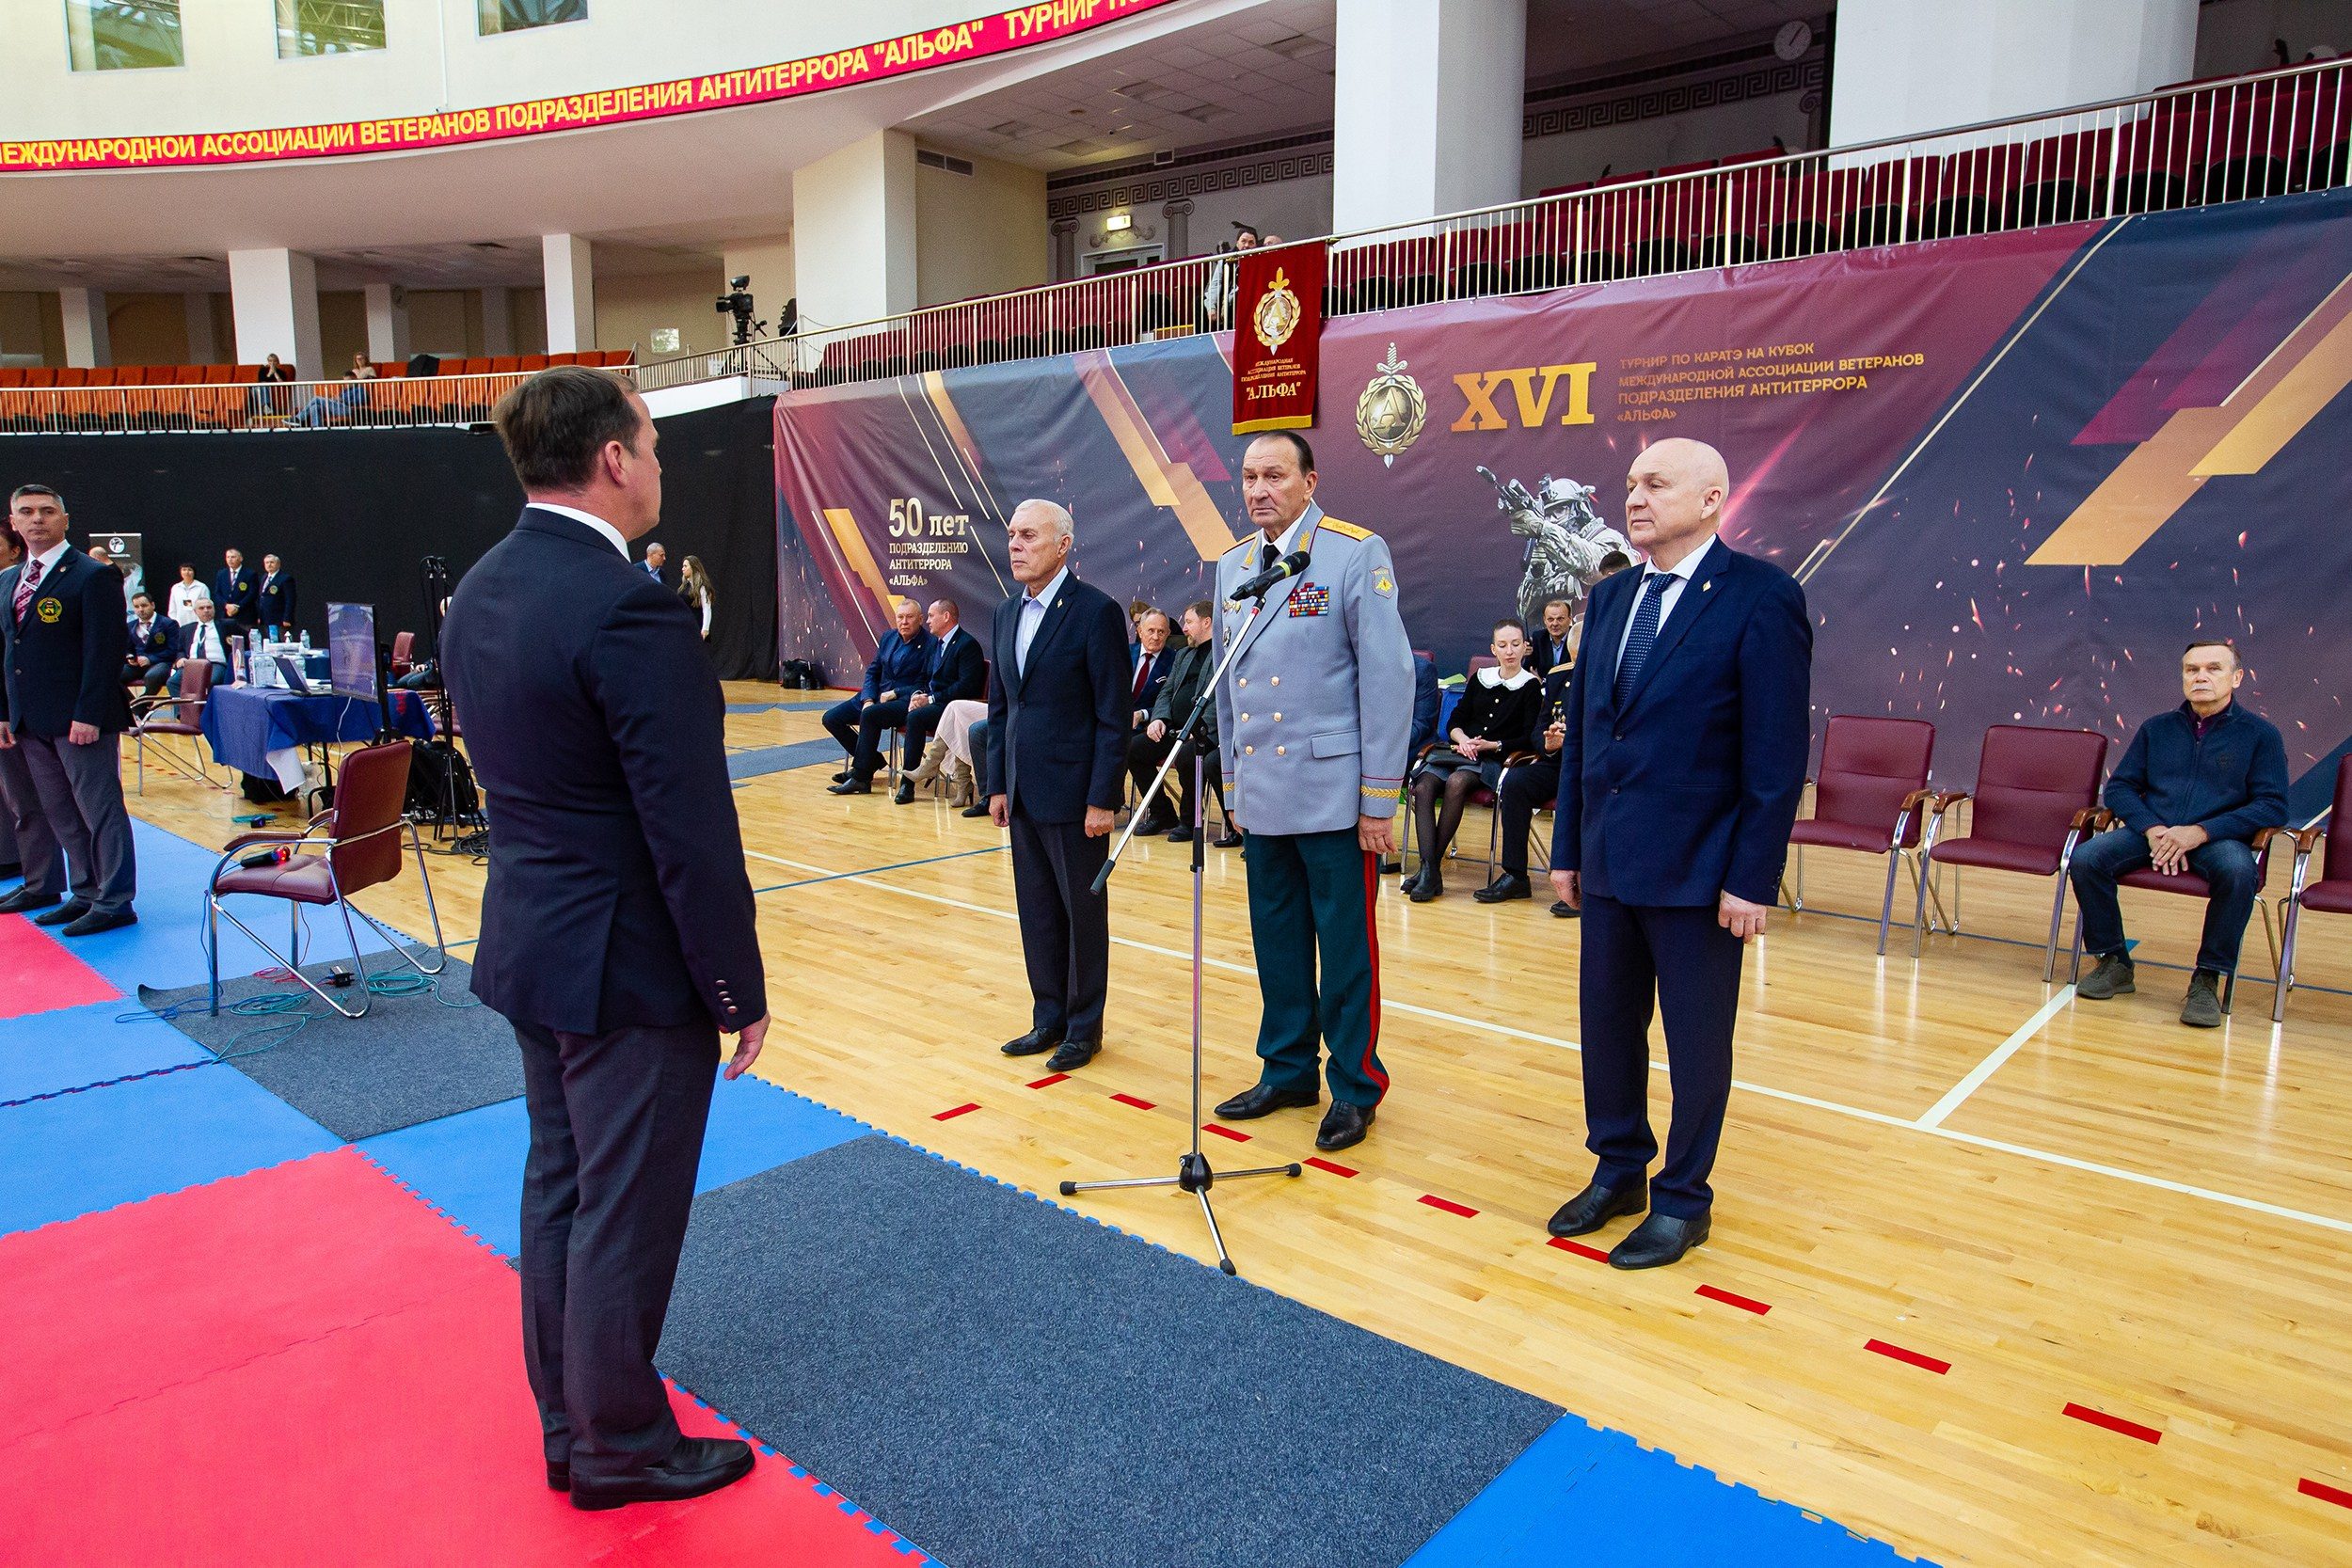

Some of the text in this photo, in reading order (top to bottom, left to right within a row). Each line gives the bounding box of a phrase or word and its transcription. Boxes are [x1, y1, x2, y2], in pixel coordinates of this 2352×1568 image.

[201, 123, 355, 157] АССОЦИАЦИИ
[359, 109, 490, 145] ВЕТЕРАНОВ
[496, 80, 692, 130] ПОДРАЗДЕЛЕНИЯ
[698, 48, 869, 103] АНТИТЕРРОРА
[873, 20, 984, 68] "АЛЬФА"
[1004, 0, 1102, 40] ТУРНИР
[1620, 342, 1814, 370] ТУРНИР ПО КАРАТЭ НА КУБОК
[1618, 353, 1925, 388] МЕЖДУНАРОДНОЙ АССОЦИАЦИИ ВЕТЕРАНОВ
[1246, 382, 1301, 401] "АЛЬФА"
[1451, 361, 1597, 432] XVI
[1618, 376, 1867, 405] ПОДРАЗДЕЛЕНИЯ АНТИТЕРРОРА
[1617, 408, 1677, 422] «АЛЬФА»
[889, 497, 969, 538] 50 лет
[889, 542, 969, 556] ПОДРАЗДЕЛЕНИЮ
[889, 559, 952, 570] АНТИТЕРРОРА
[889, 575, 928, 586] «АЛЬФА»
